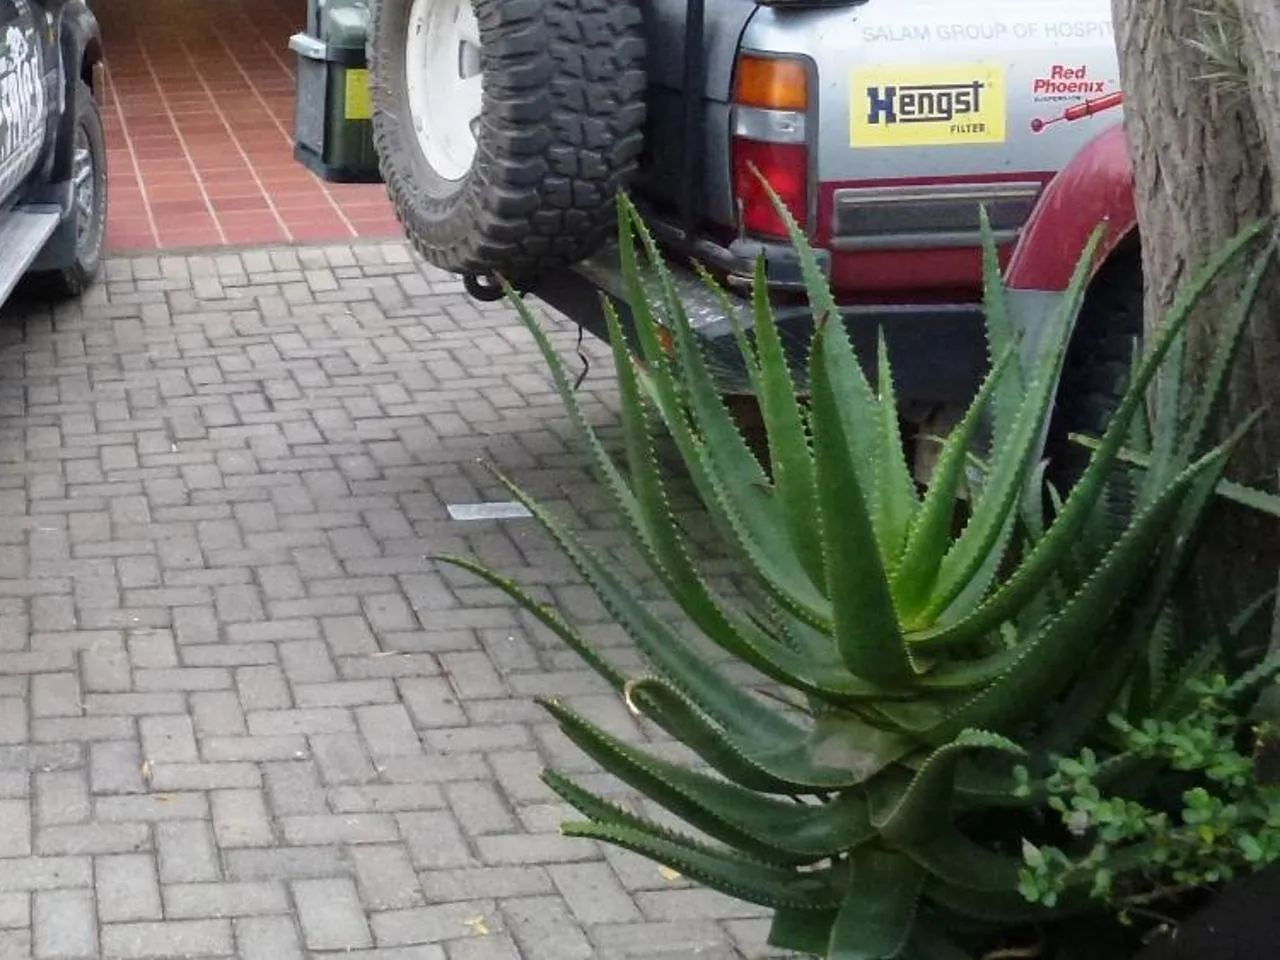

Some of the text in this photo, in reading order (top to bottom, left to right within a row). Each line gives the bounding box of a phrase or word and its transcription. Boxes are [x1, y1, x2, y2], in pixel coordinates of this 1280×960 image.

[863, 26, 931, 42] SALAM
[936, 23, 1008, 41] GROUP
[1013, 21, 1038, 39] OF
[1051, 65, 1086, 80] Red
[1033, 79, 1105, 93] Phoenix
[866, 80, 984, 125] Hengst
[950, 123, 986, 133] FILTER
